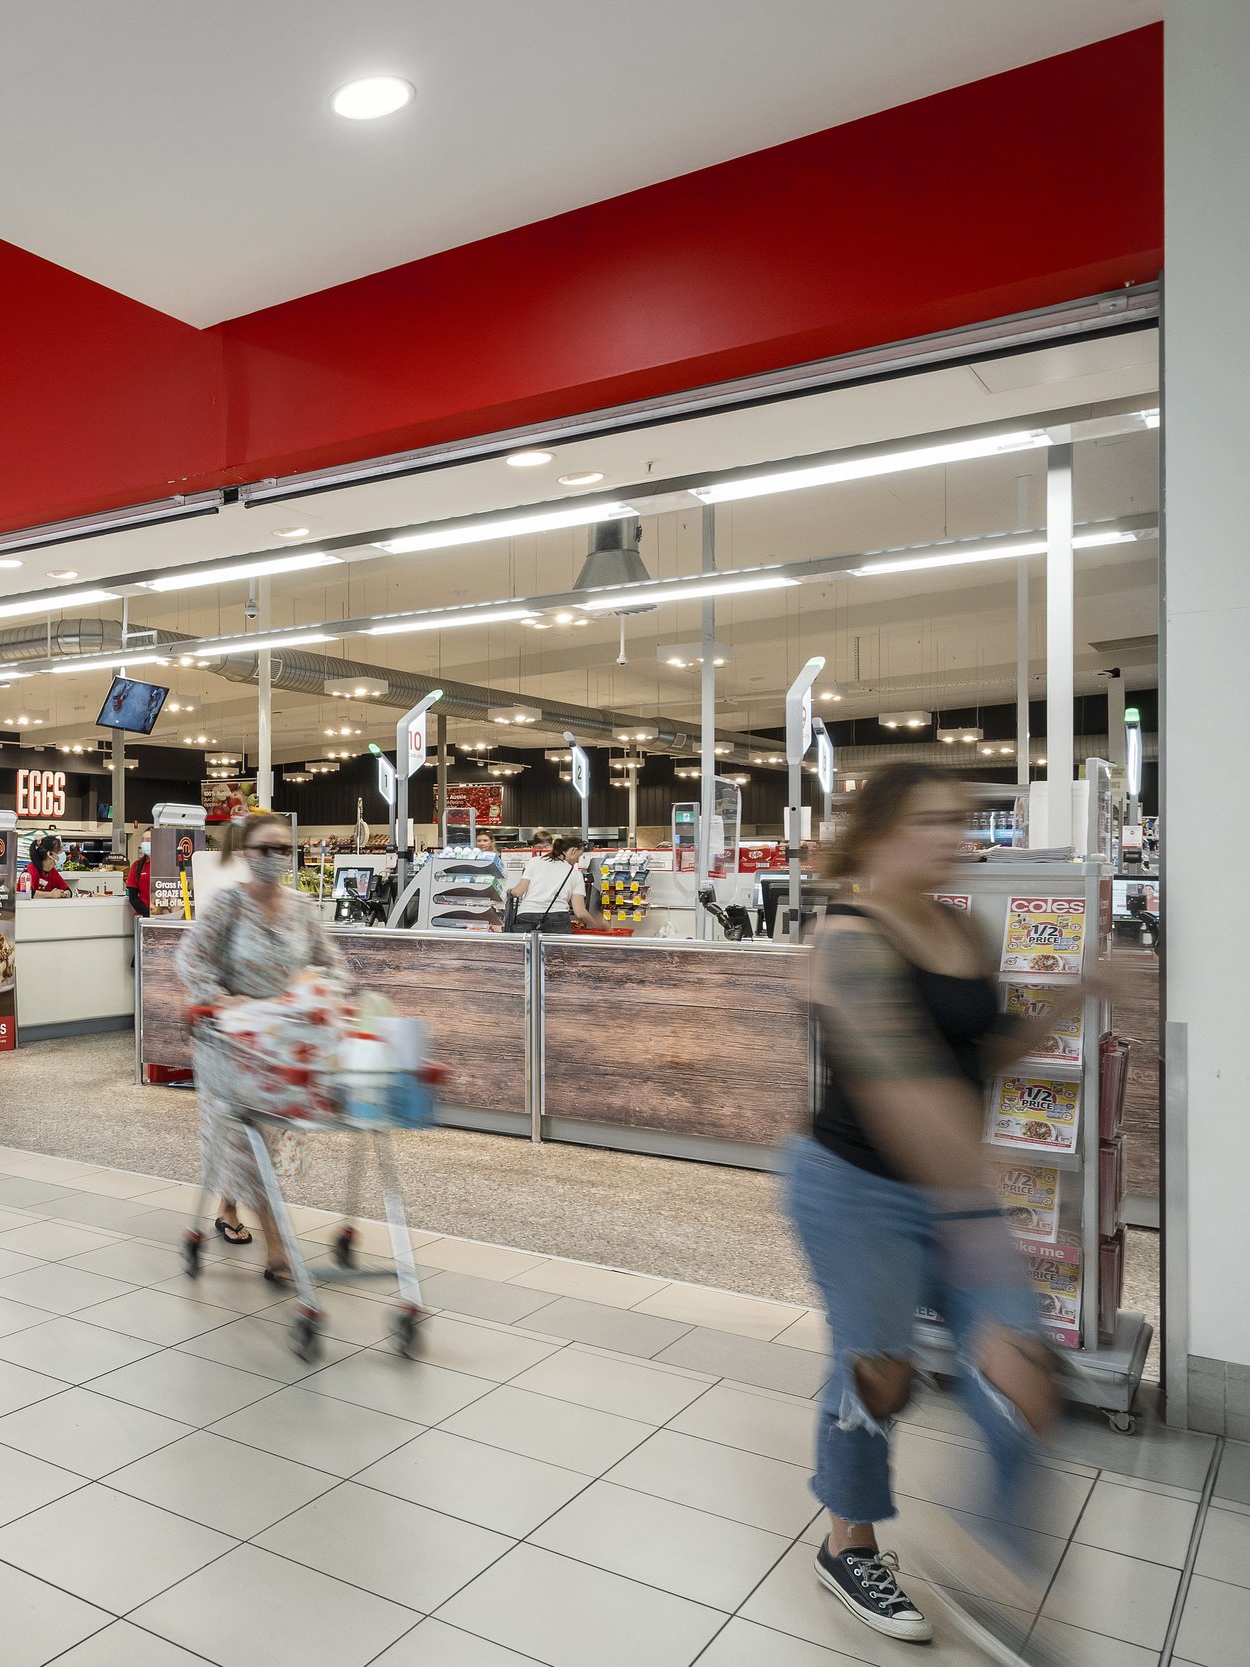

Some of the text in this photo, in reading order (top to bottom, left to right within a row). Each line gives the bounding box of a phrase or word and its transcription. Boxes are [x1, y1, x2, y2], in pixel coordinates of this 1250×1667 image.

[577, 765, 582, 780] 2
[16, 769, 66, 818] EGGS
[155, 880, 177, 889] Grass
[155, 889, 180, 898] GRAZE
[155, 899, 169, 907] Full
[169, 899, 177, 907] of
[1011, 898, 1084, 914] coles
[1031, 924, 1059, 937] 1/2
[1028, 936, 1060, 944] PRICE
[1025, 1086, 1052, 1102] 1/2
[1021, 1099, 1054, 1110] PRICE
[1006, 1170, 1033, 1187] 1/2
[1002, 1183, 1034, 1195] PRICE
[1040, 1247, 1065, 1258] me
[1027, 1270, 1057, 1281] PRICE
